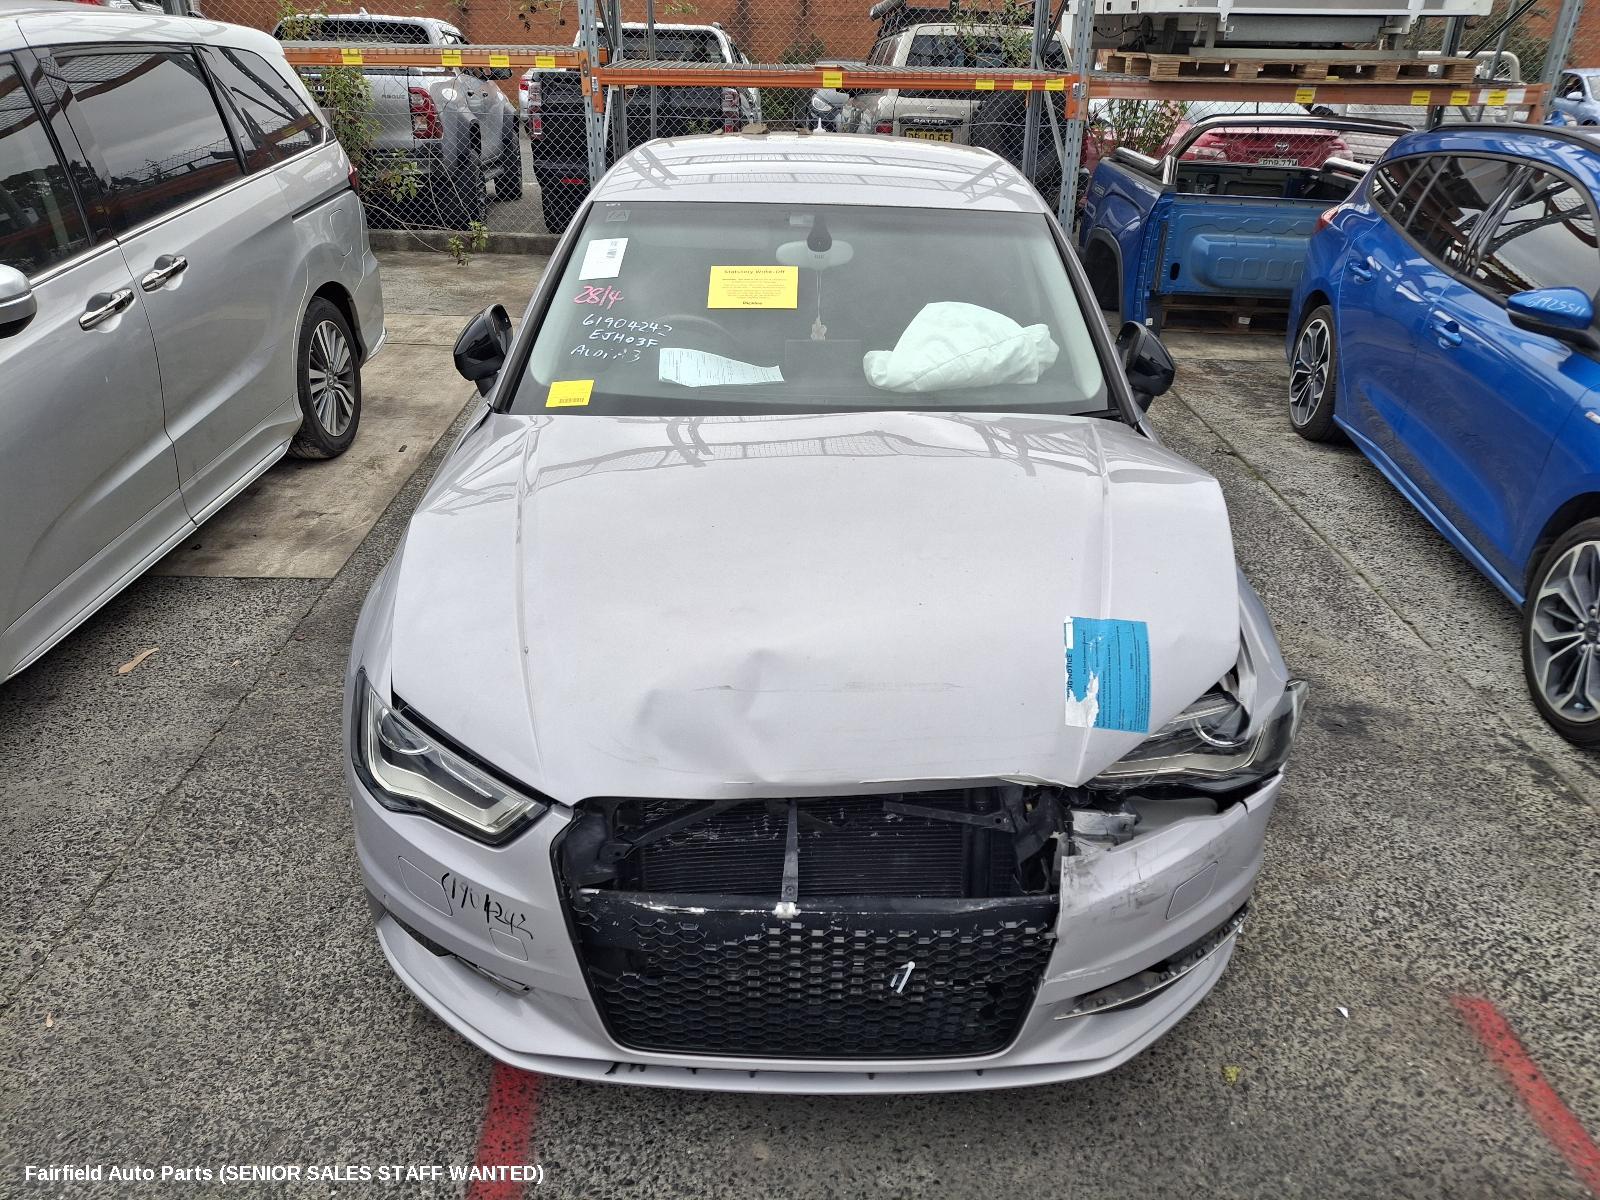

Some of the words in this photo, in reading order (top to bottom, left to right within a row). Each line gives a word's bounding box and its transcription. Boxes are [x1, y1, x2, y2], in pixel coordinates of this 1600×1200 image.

[573, 284, 625, 310] 28/4
[589, 328, 659, 348] EJH03F
[1066, 653, 1074, 679] NOTICE
